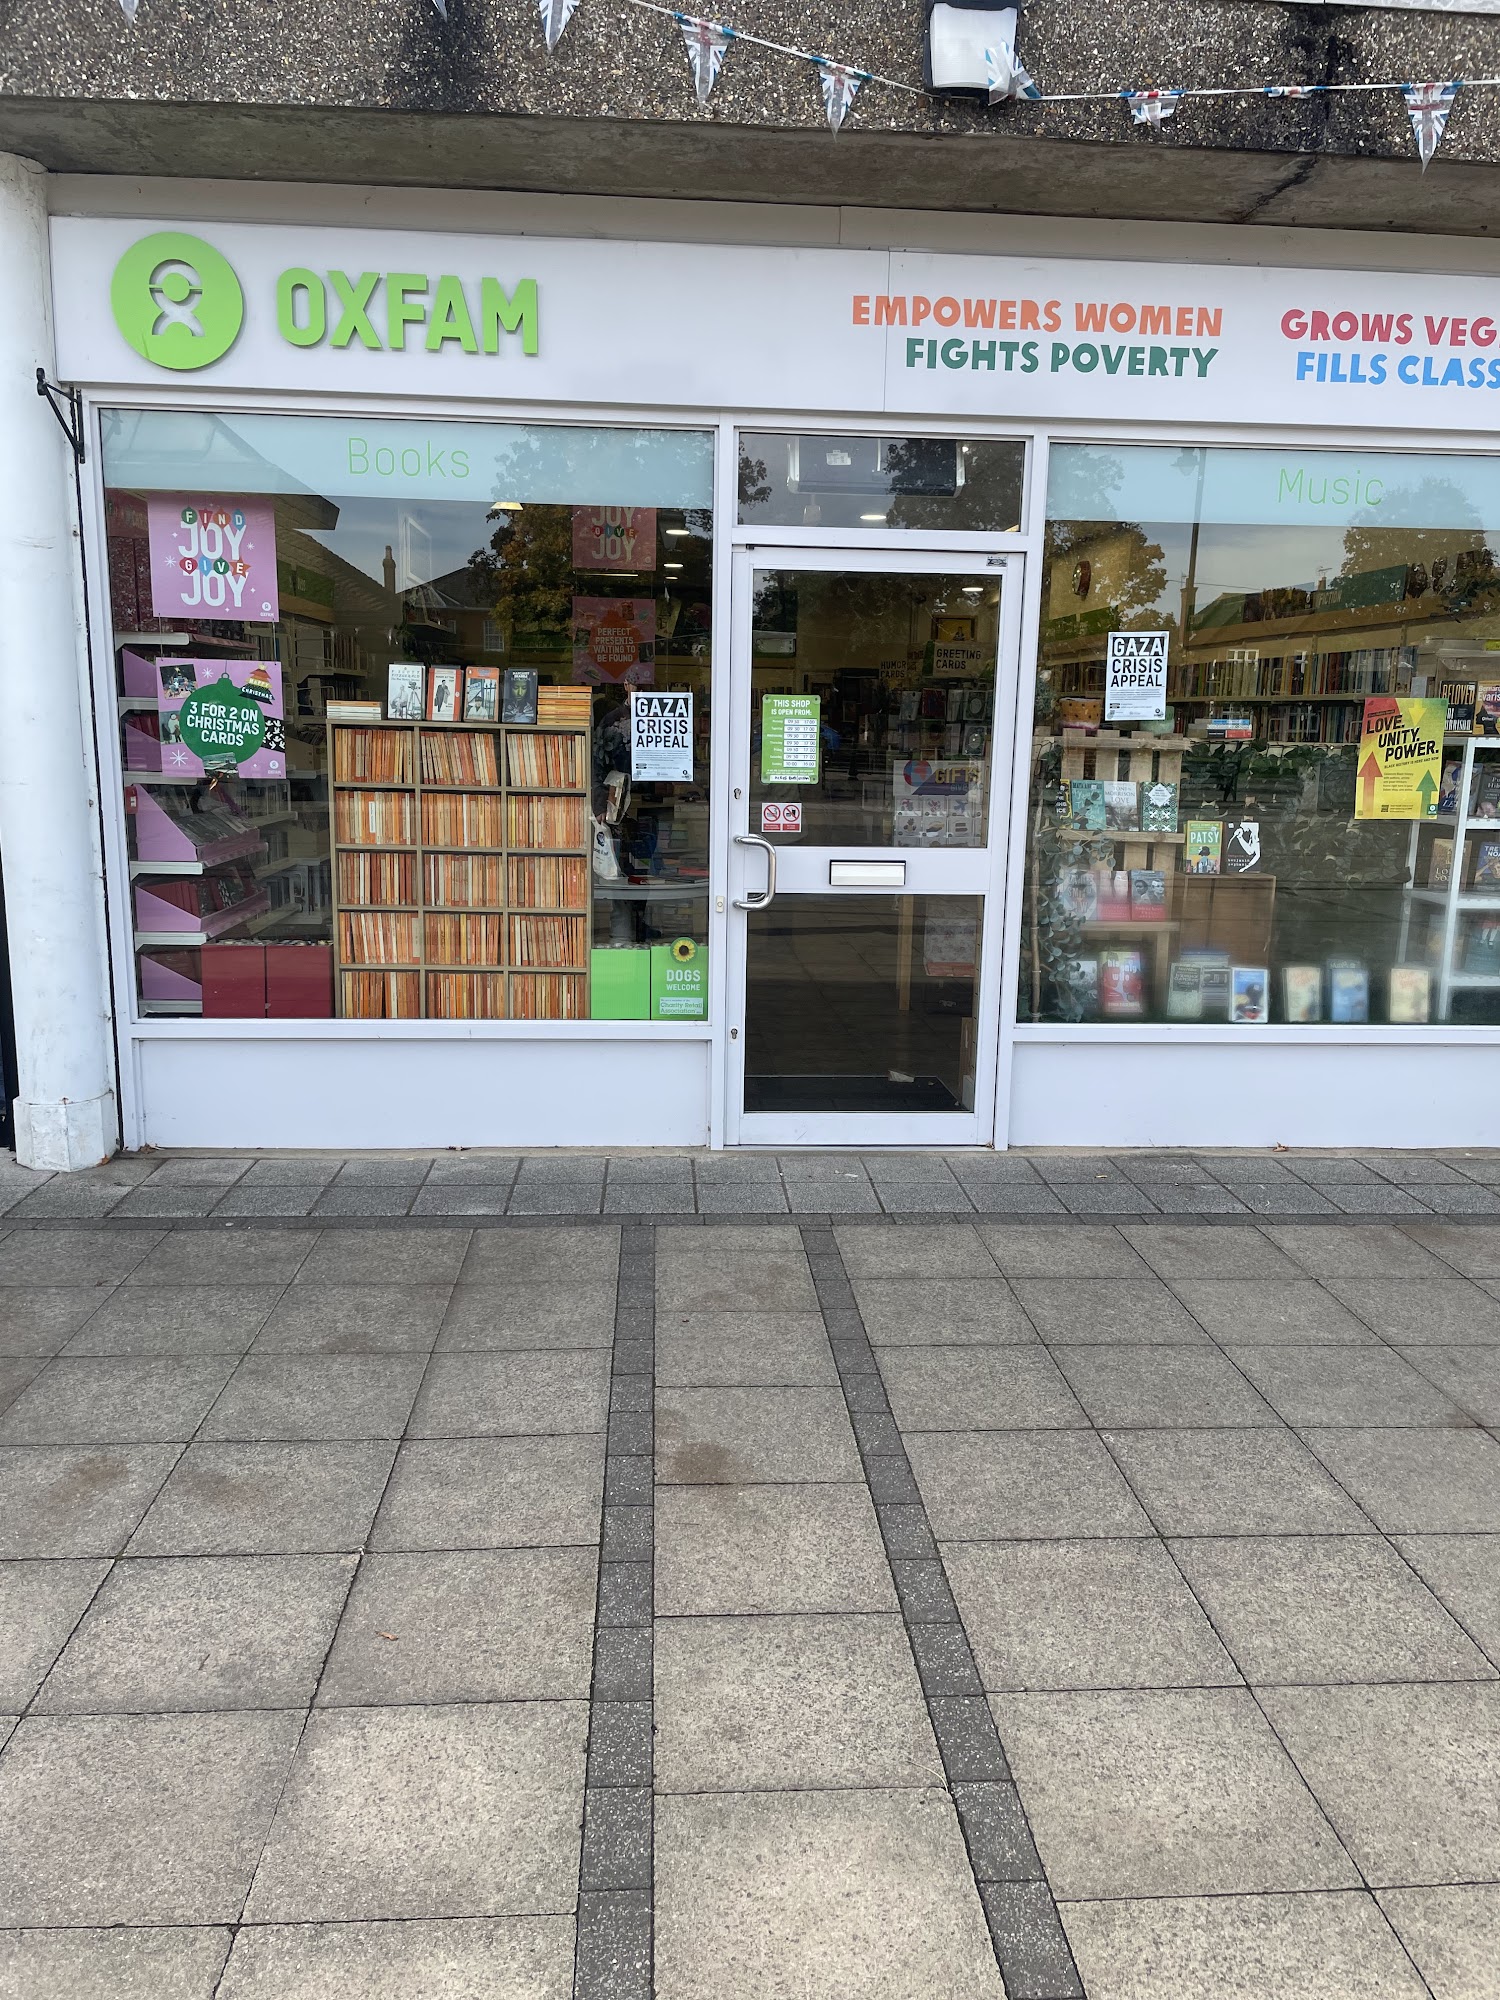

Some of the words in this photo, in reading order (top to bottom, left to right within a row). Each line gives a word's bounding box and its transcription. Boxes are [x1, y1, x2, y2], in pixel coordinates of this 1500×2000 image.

[276, 267, 539, 356] OXFAM
[852, 295, 1062, 333] EMPOWERS
[1074, 302, 1223, 337] WOMEN
[1280, 309, 1414, 346] GROWS
[1424, 317, 1500, 348] VEG
[905, 338, 1039, 374] FIGHTS
[1050, 343, 1219, 378] POVERTY
[1296, 352, 1388, 385] FILLS
[1397, 355, 1500, 390] CLASS
[347, 438, 471, 479] Books
[1277, 468, 1384, 506] Music
[185, 510, 243, 523] FIND
[591, 507, 636, 528] JOY
[178, 521, 247, 560] JOY
[594, 527, 635, 537] GIVE
[591, 534, 638, 562] JOY
[184, 560, 244, 574] GIVE
[180, 569, 249, 607] JOY
[597, 627, 632, 636] PERFECT
[592, 645, 624, 653] WAITING
[626, 645, 636, 653] TO
[595, 636, 634, 645] PRESENTS
[1113, 637, 1164, 656] GAZA
[597, 654, 607, 662] BE
[608, 654, 633, 662] FOUND
[936, 648, 982, 660] GREETING
[935, 659, 967, 670] CARDS
[1112, 658, 1163, 673] CRISIS
[1110, 674, 1163, 688] APPEAL
[241, 686, 273, 700] CHRISTMAS
[1442, 684, 1475, 705] BELOVED
[189, 702, 198, 714] 3
[201, 702, 226, 718] FOR
[229, 707, 238, 719] 2
[241, 708, 258, 722] ON
[636, 698, 688, 717] GAZA
[791, 700, 811, 708] SHOP
[186, 715, 260, 735] CHRISTMAS
[636, 719, 688, 734] CRISIS
[1366, 714, 1405, 735] LOVE.
[201, 730, 244, 746] CARDS
[635, 735, 689, 748] APPEAL
[1378, 727, 1420, 748] UNITY.
[1385, 740, 1439, 763] POWER.
[935, 767, 979, 784] GIFTS
[1190, 831, 1219, 843] PATSY
[1107, 959, 1119, 967] his
[666, 969, 701, 982] DOGS
